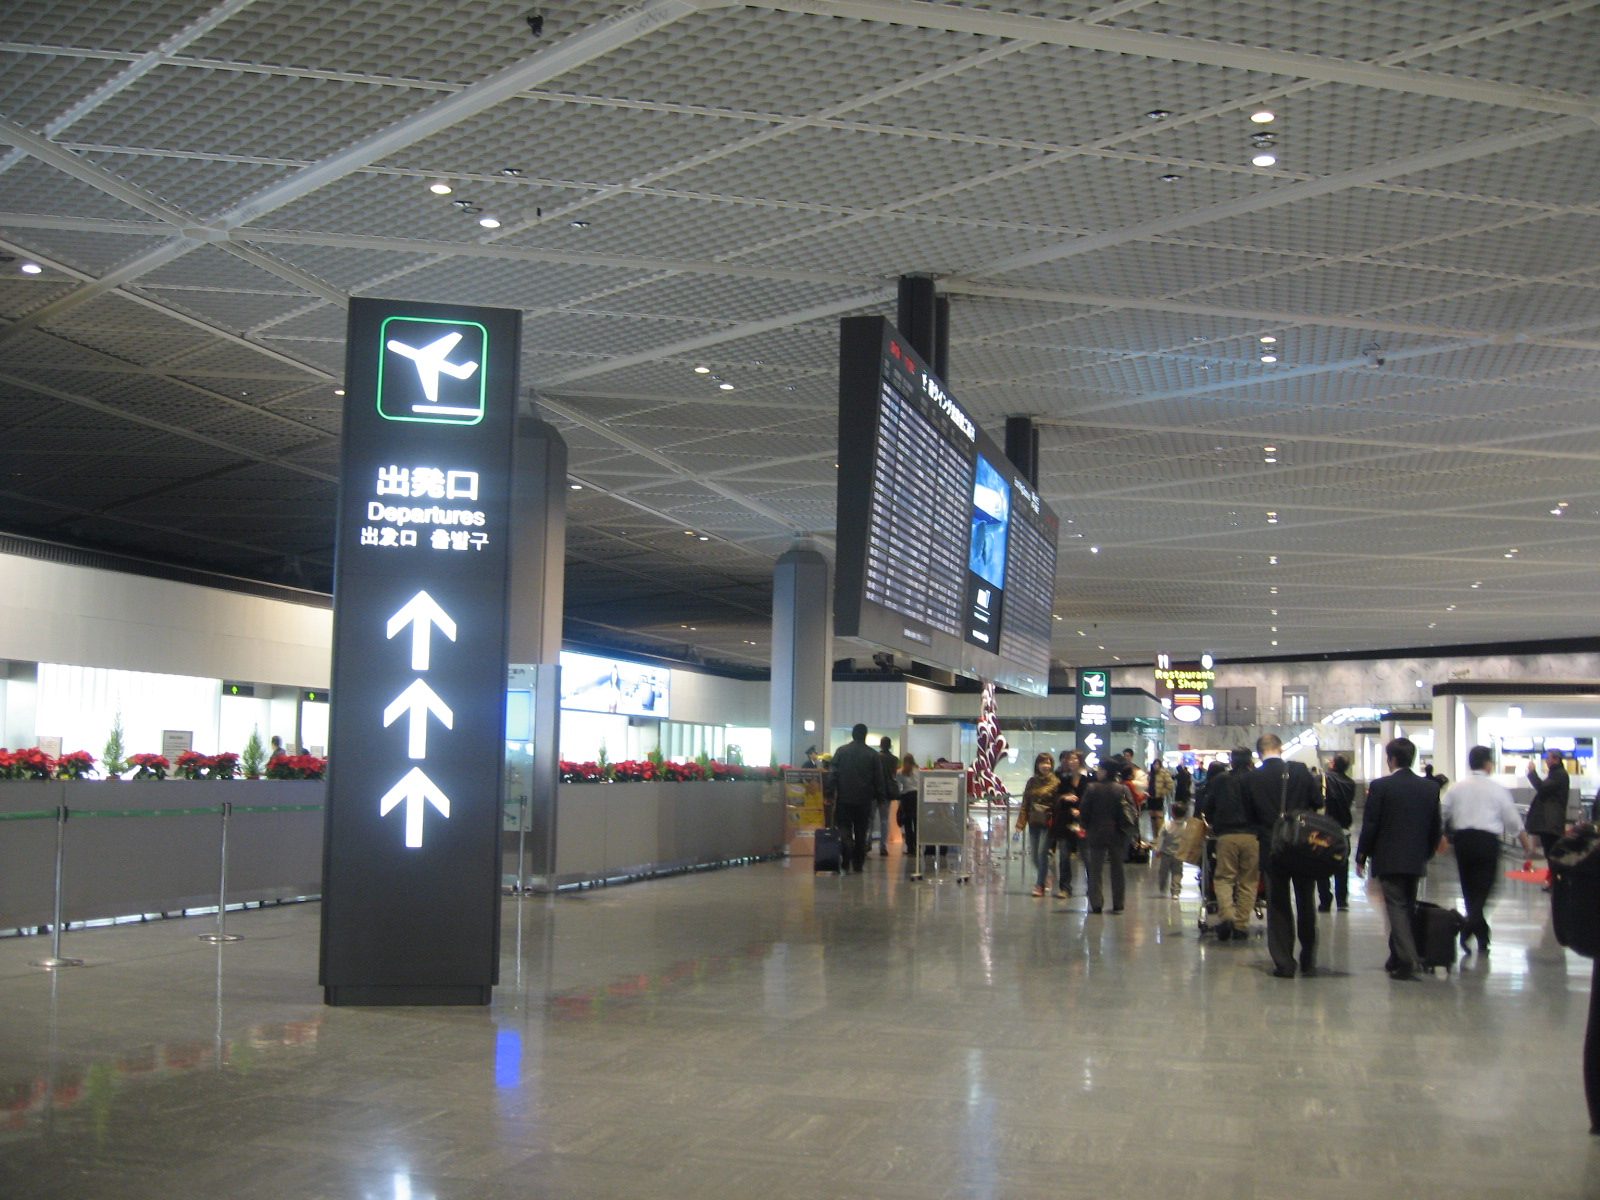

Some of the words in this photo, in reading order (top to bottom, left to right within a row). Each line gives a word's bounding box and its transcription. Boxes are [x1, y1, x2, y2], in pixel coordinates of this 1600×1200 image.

[377, 464, 479, 501] 出発口
[367, 501, 486, 527] Departures
[360, 526, 418, 547] 出发口
[1154, 669, 1216, 680] Restaurants
[1166, 679, 1175, 689] &
[1177, 679, 1208, 691] Shops
